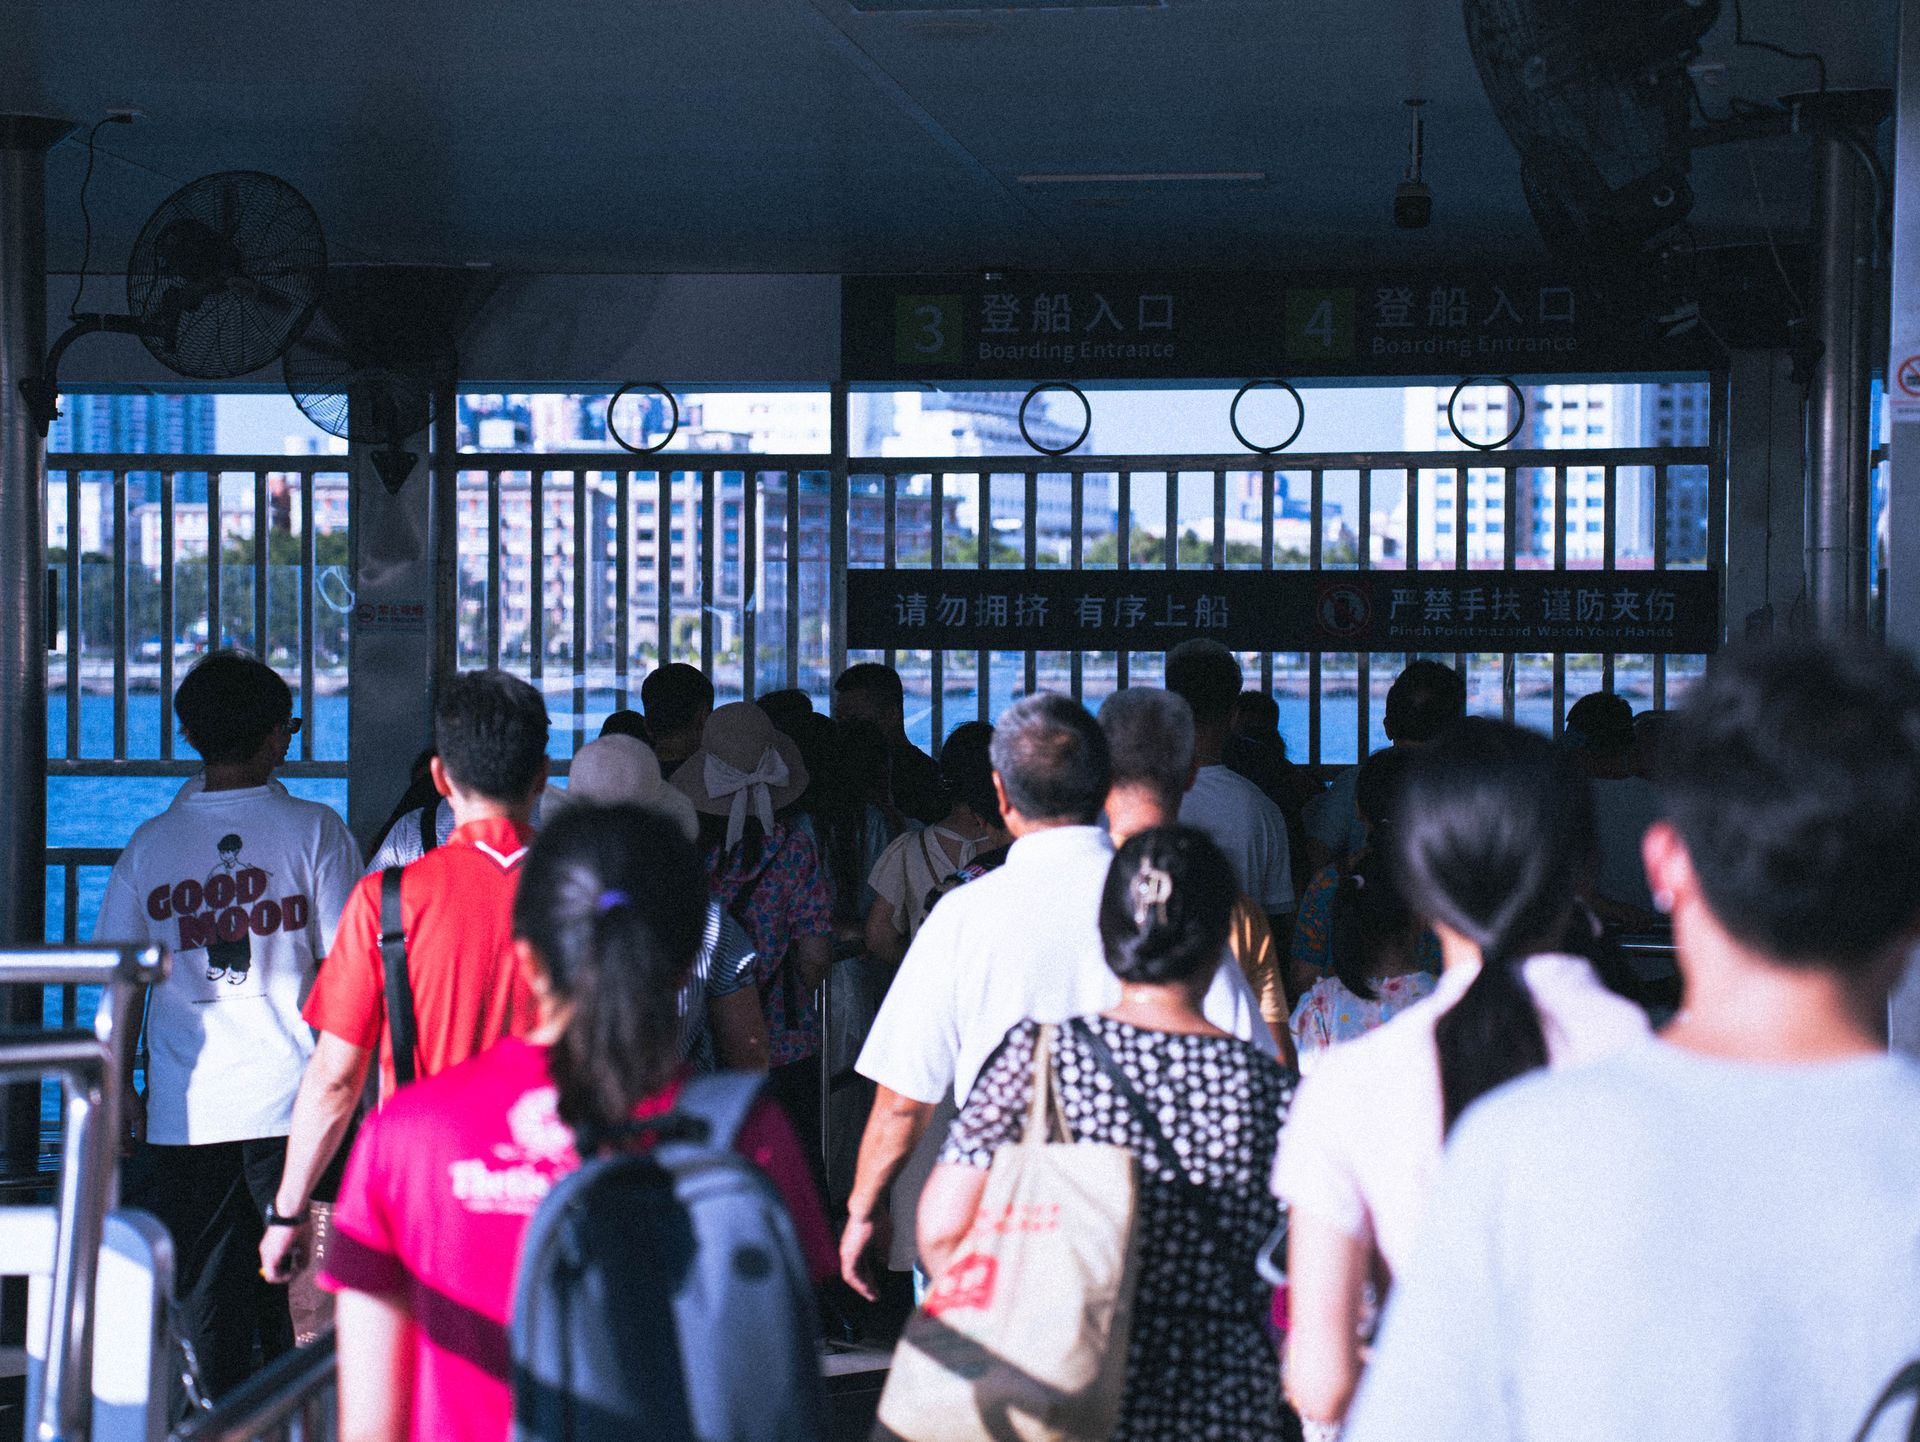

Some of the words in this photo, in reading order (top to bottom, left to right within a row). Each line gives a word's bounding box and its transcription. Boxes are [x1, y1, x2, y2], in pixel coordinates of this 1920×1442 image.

[913, 304, 945, 353] 3
[979, 293, 1175, 333] 登船入口
[1303, 299, 1335, 347] 4
[1374, 287, 1576, 328] 登船入口
[978, 342, 1075, 363] Boarding
[1080, 341, 1176, 358] Entrance
[1372, 337, 1472, 357] Boarding
[1478, 335, 1577, 353] Entrance
[894, 593, 1050, 628] 请勿拥挤
[1074, 593, 1230, 628] 有序上船
[1389, 588, 1521, 622] 严禁手扶
[1542, 587, 1676, 622] 谨防夹伤
[1389, 626, 1431, 637] Pinch
[1435, 626, 1474, 637] Point
[1537, 626, 1583, 637] Watch
[1625, 626, 1674, 637] Hands
[147, 868, 267, 921] GOOD
[178, 894, 309, 951] MOOD
